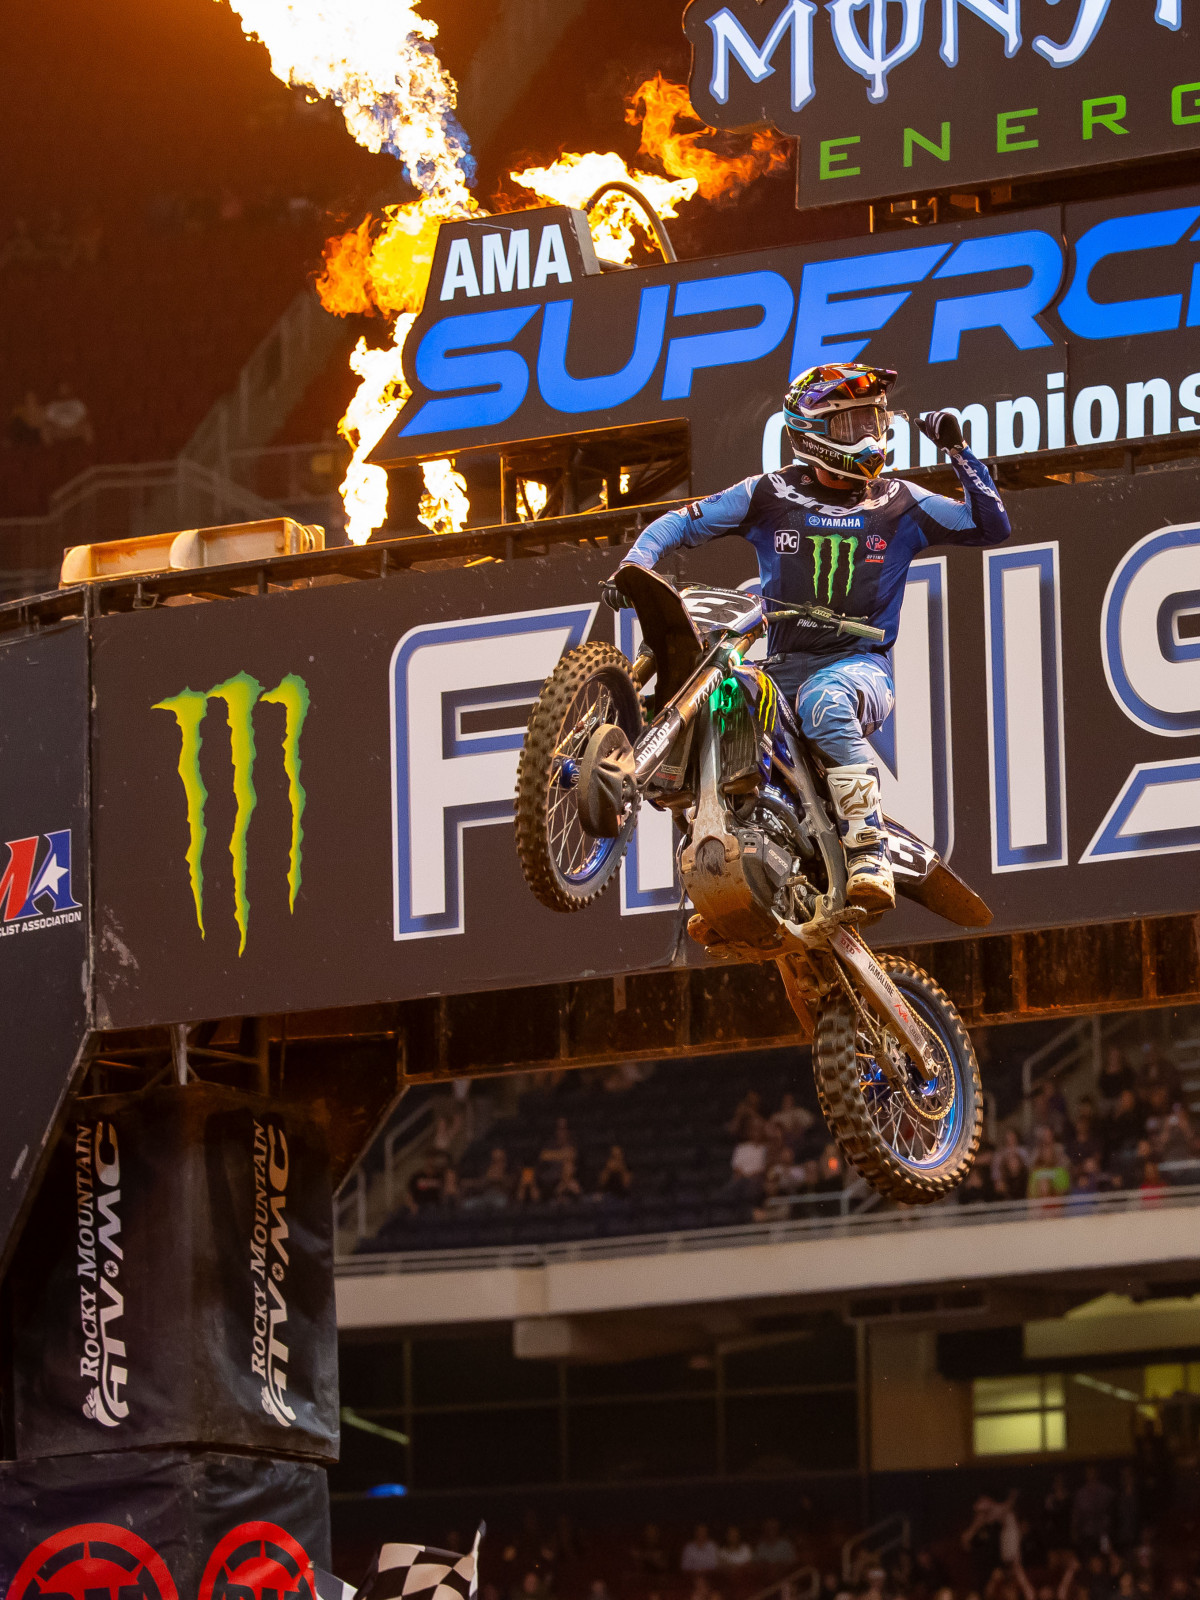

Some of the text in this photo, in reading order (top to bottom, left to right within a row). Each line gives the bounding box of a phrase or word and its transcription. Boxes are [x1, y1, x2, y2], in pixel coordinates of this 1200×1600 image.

[440, 223, 573, 301] AMA
[775, 532, 798, 551] PPG
[821, 517, 861, 528] YAMAHA
[636, 721, 671, 763] DUNLOP
[22, 911, 82, 933] ASSOCIATION
[867, 961, 895, 997] YAMALUBE
[75, 1123, 100, 1381] ROCKY MOUNTAIN
[250, 1121, 271, 1381] ROCKY MOUNTAIN
